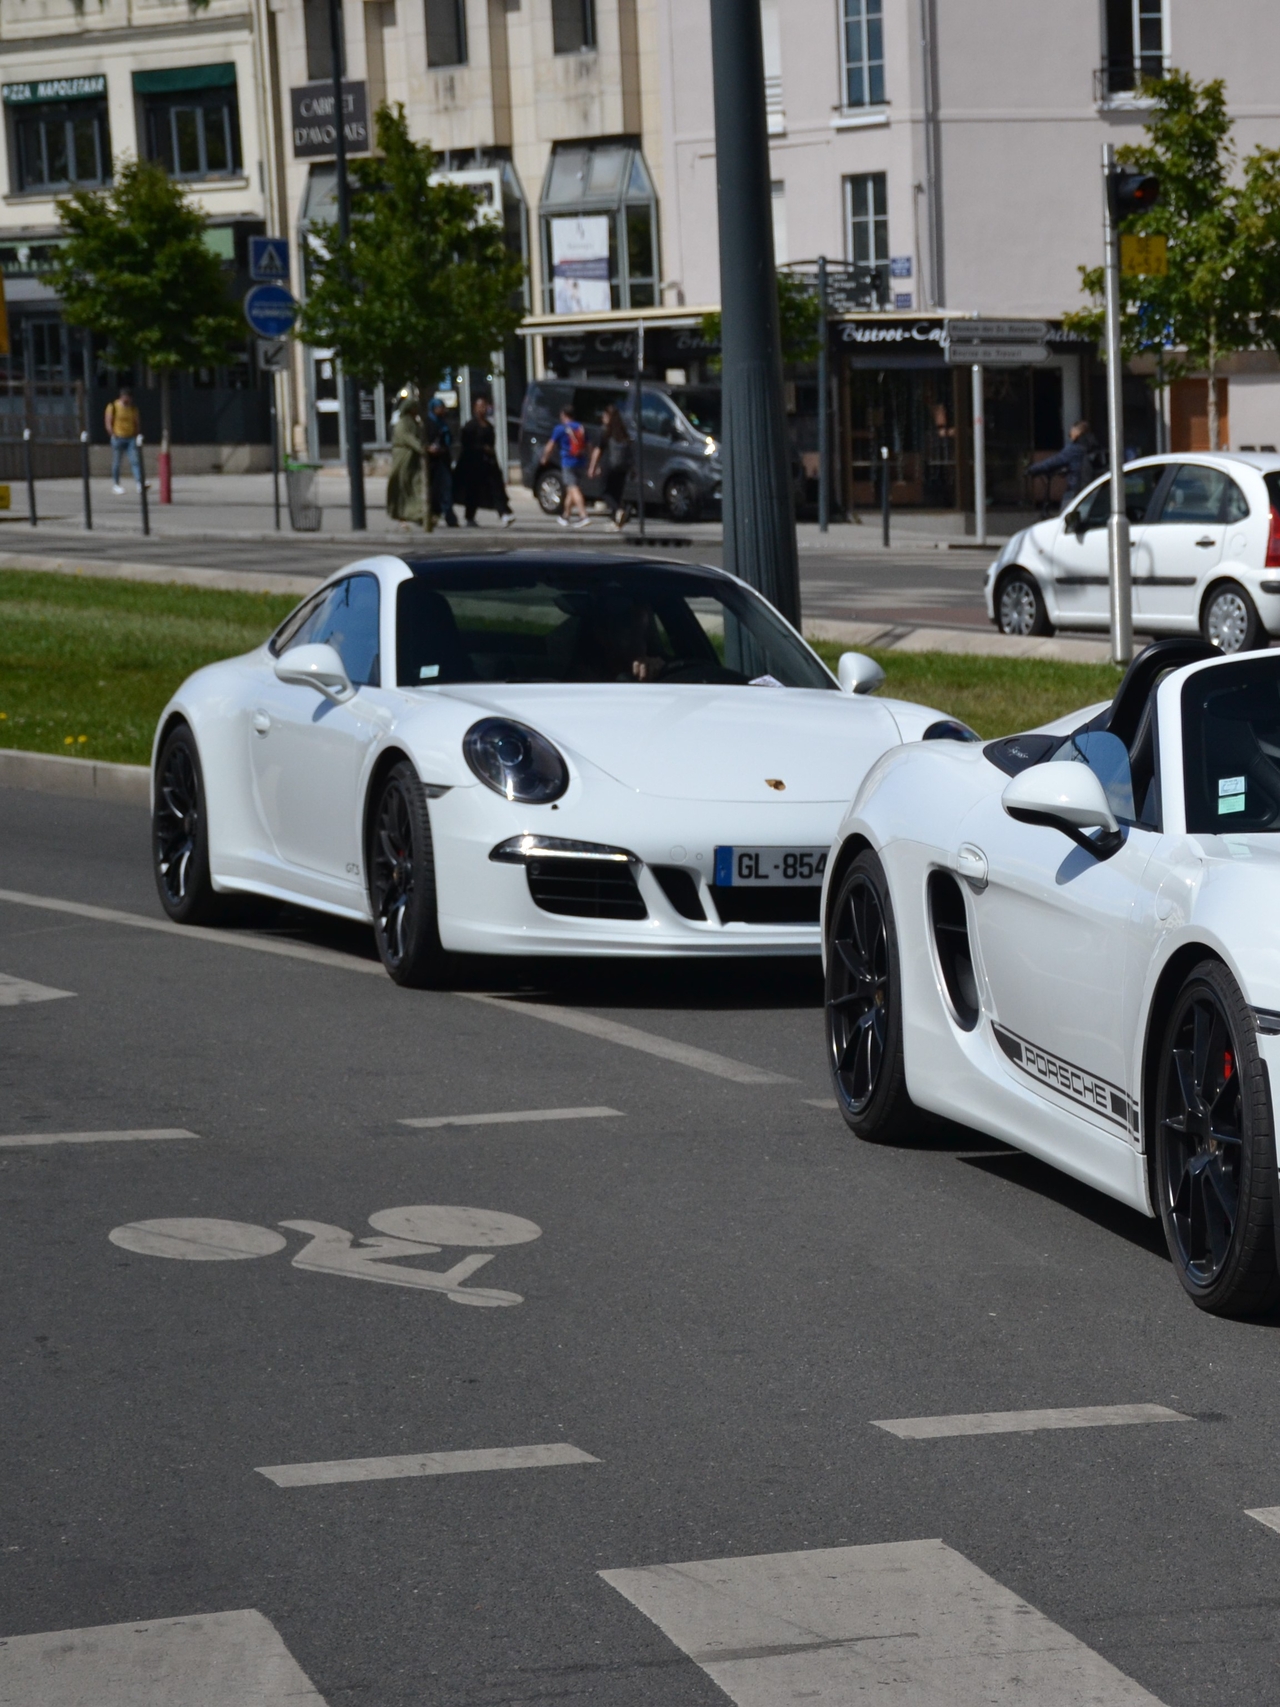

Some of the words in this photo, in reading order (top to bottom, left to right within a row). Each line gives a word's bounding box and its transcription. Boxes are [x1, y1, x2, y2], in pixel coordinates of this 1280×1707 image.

[294, 122, 367, 147] D'AVOATS
[836, 321, 951, 348] Bistrot-Caf
[1025, 1046, 1107, 1109] PORSCHE
